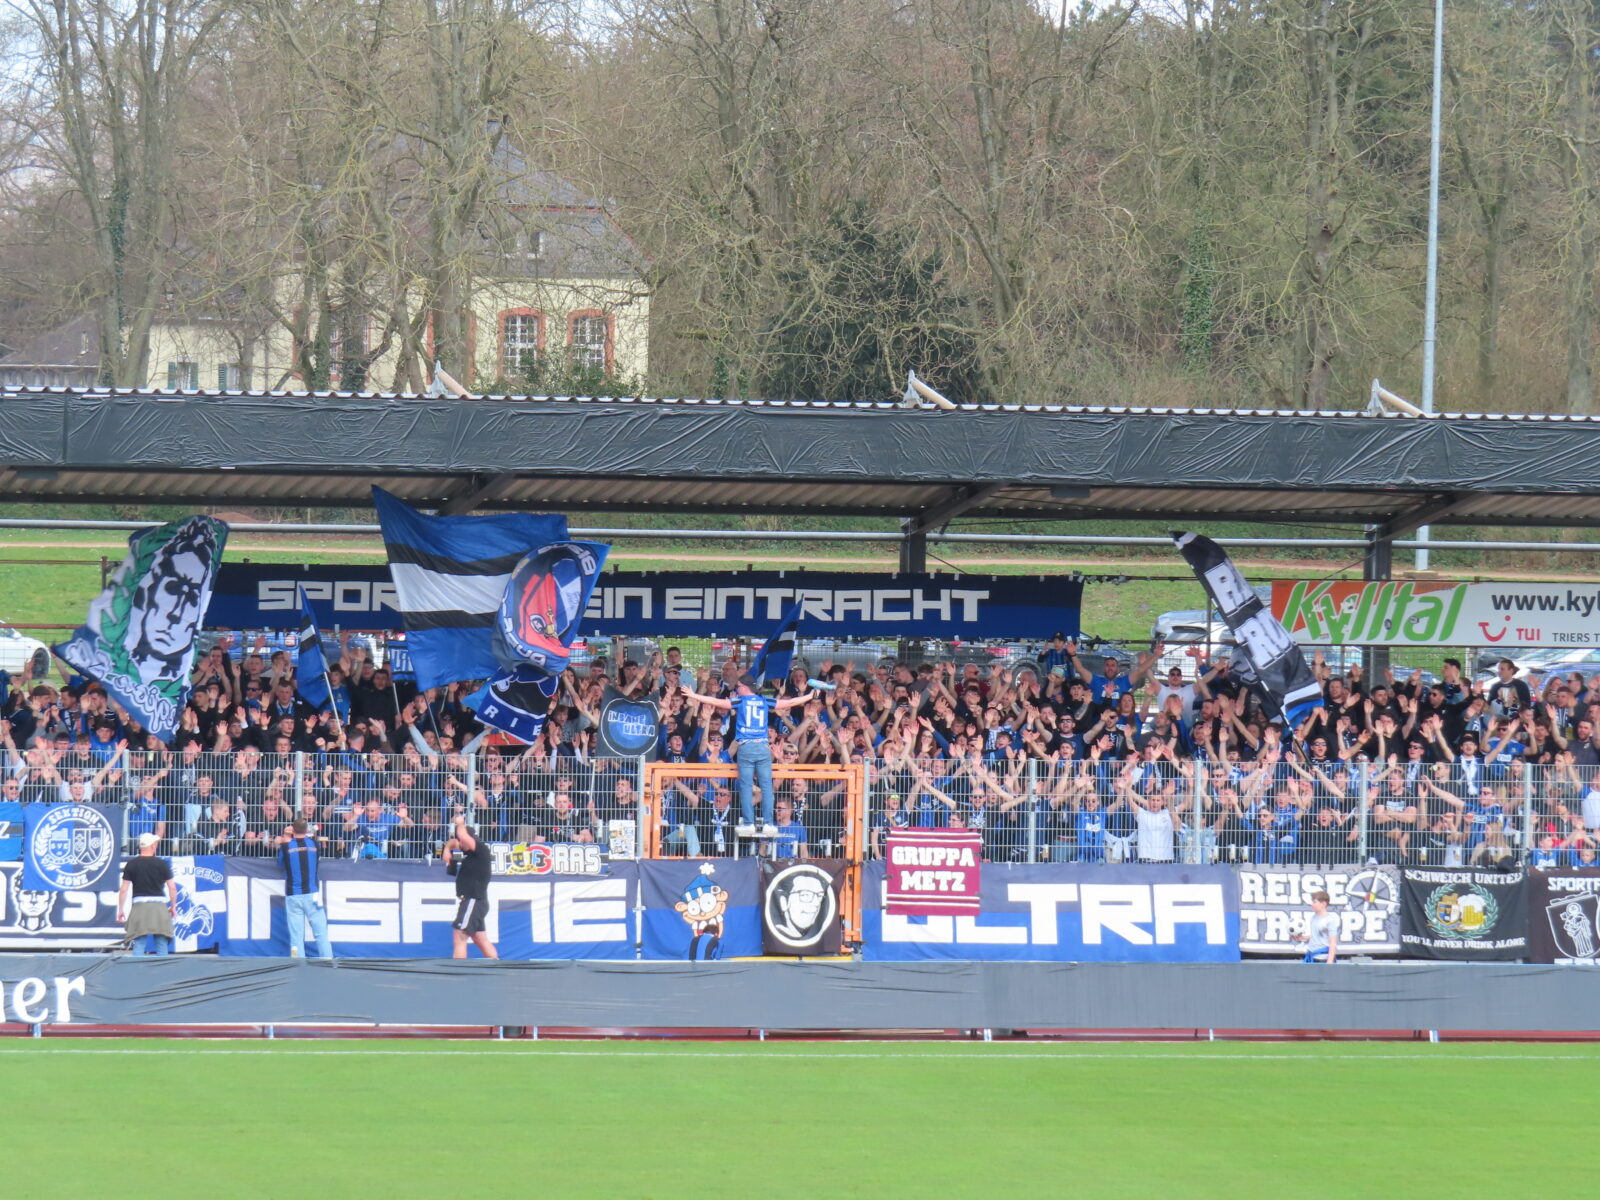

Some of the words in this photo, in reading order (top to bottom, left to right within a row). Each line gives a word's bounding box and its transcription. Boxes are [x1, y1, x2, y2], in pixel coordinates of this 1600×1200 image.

[665, 587, 991, 622] EINTRACHT
[1281, 580, 1470, 645] Kylltal
[1516, 628, 1541, 641] TUI
[1552, 632, 1591, 643] TRIERS
[745, 705, 765, 728] 14
[623, 723, 656, 737] ULTRA
[48, 807, 101, 825] SEKTION
[891, 845, 976, 867] GRUPPA
[55, 873, 89, 886] KONZ
[181, 866, 224, 884] JUGEND
[900, 870, 966, 892] METZ
[1404, 868, 1472, 884] SCHWEICH
[1474, 872, 1524, 885] UNITED
[1239, 871, 1348, 905] REISE
[1401, 934, 1432, 947] YOU'LL
[1433, 939, 1463, 949] NEVER
[1464, 940, 1494, 949] DRINK
[1495, 937, 1525, 948] ALONE
[0, 975, 86, 1023] er
